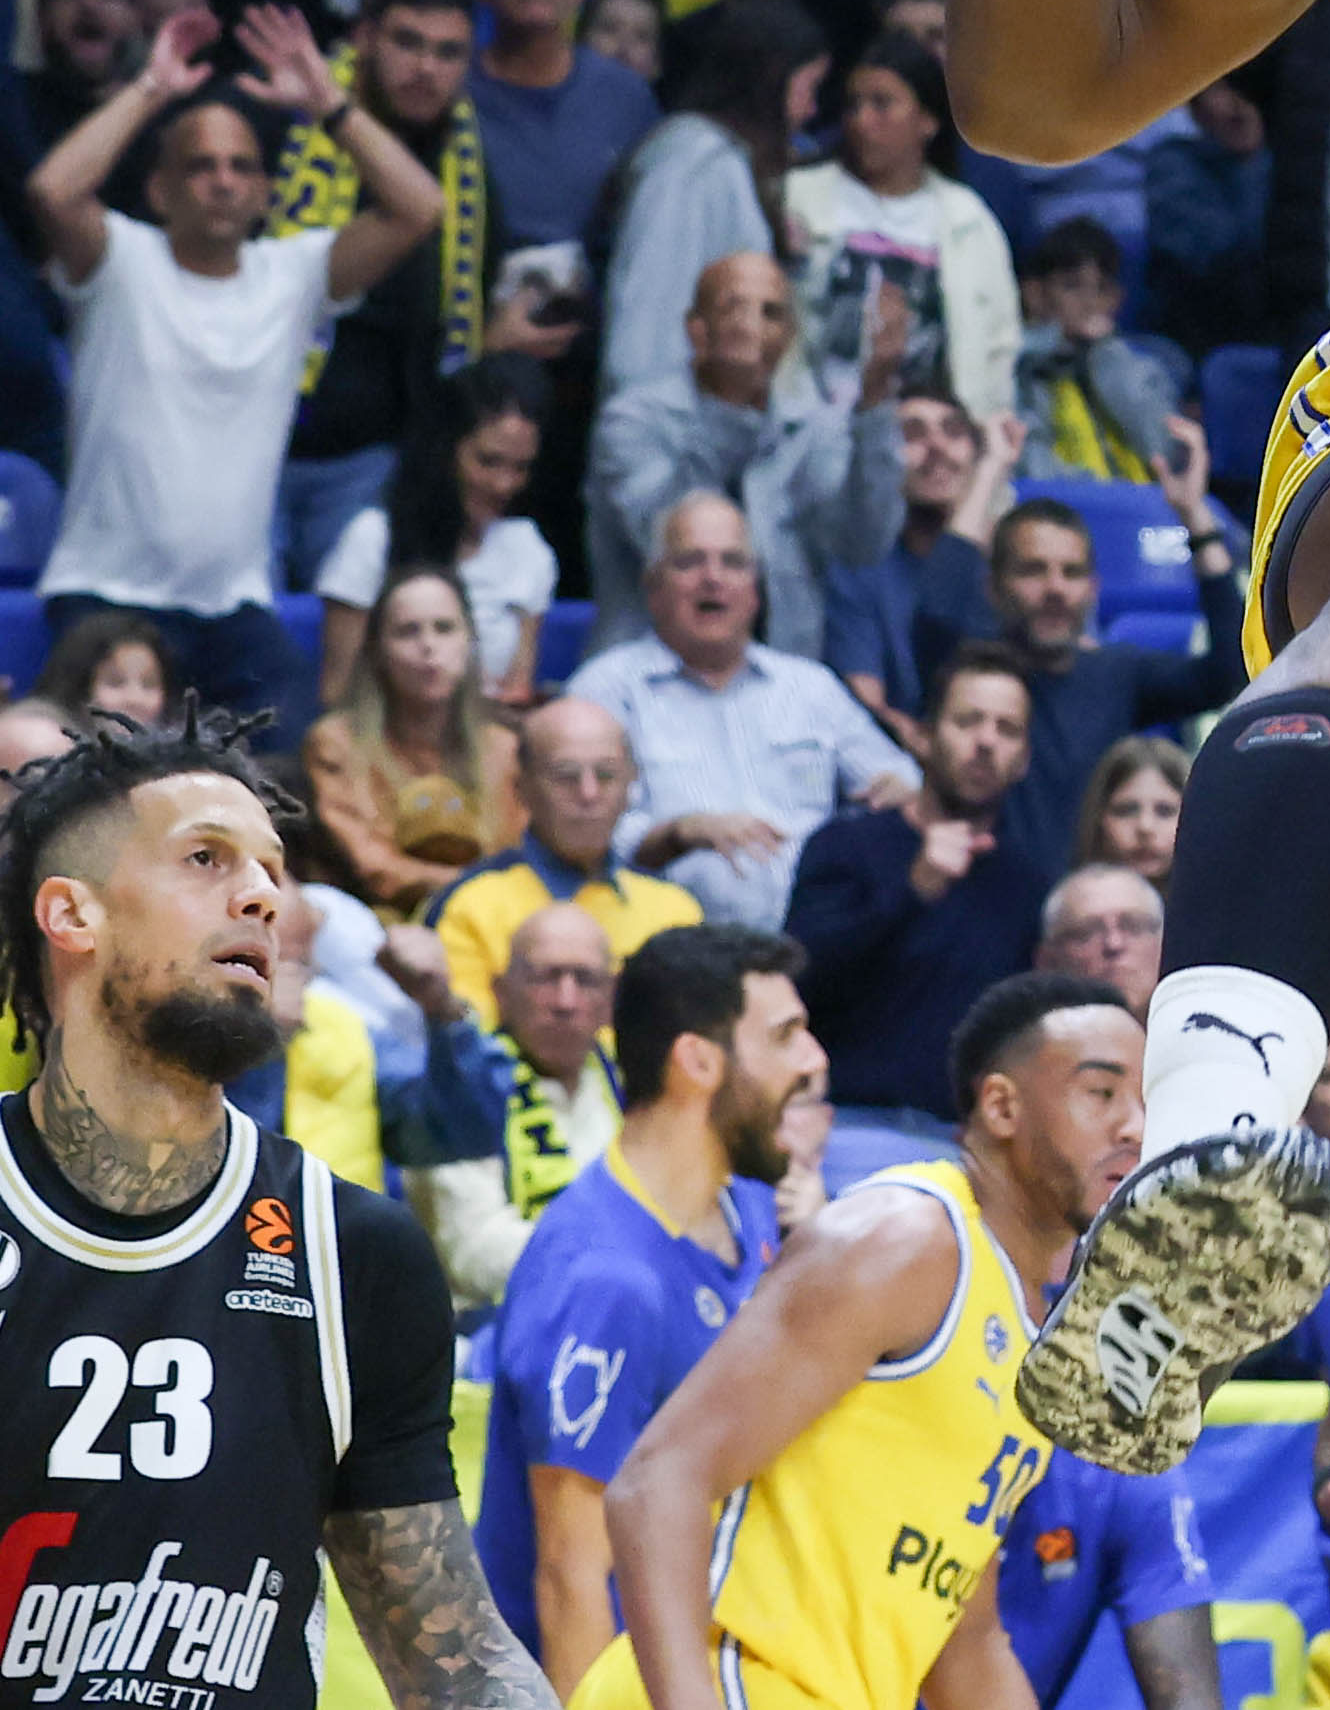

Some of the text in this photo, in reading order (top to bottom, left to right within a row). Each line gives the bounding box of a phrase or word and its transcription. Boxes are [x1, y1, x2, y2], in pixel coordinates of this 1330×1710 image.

[227, 1291, 312, 1317] oneteam
[47, 1335, 214, 1481] 23
[81, 1677, 215, 1710] ZANETTI
